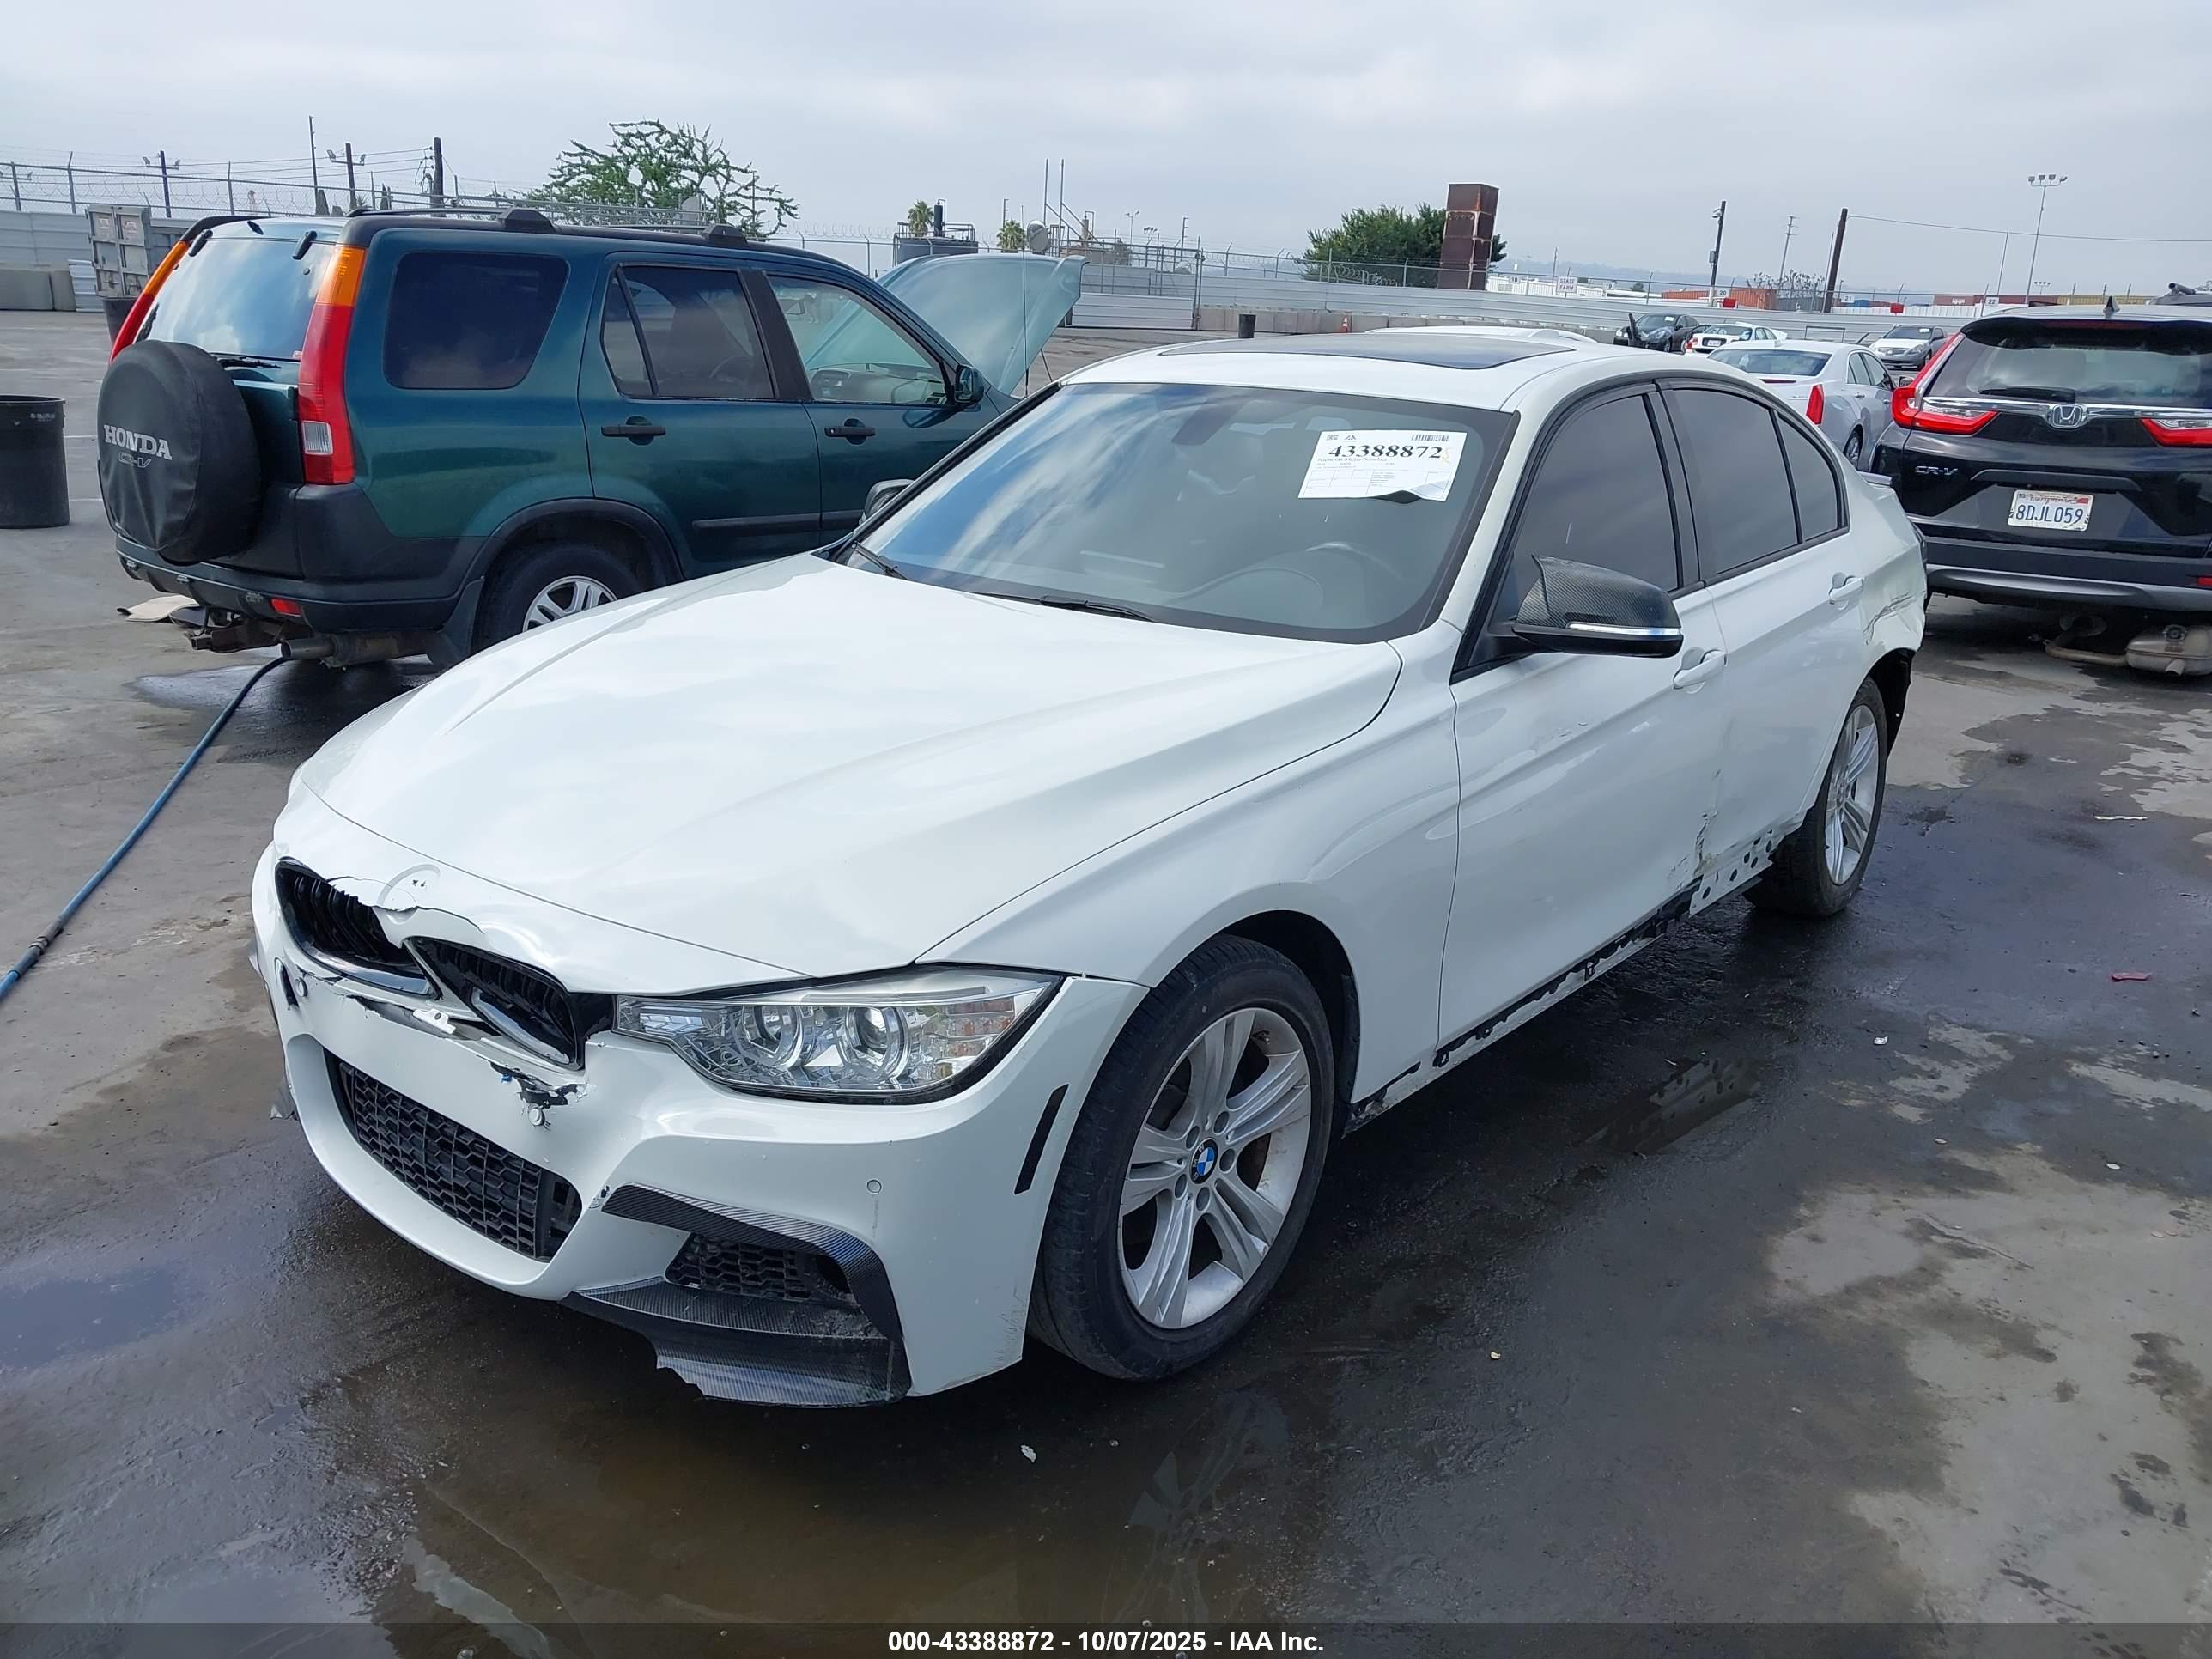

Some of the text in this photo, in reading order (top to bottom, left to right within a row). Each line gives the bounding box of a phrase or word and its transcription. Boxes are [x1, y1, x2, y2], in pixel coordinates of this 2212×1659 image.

[104, 424, 173, 460] HONDA
[1328, 444, 1443, 459] 43388872
[1915, 465, 1959, 475] CR-V
[2015, 504, 2084, 524] 8DJL059
